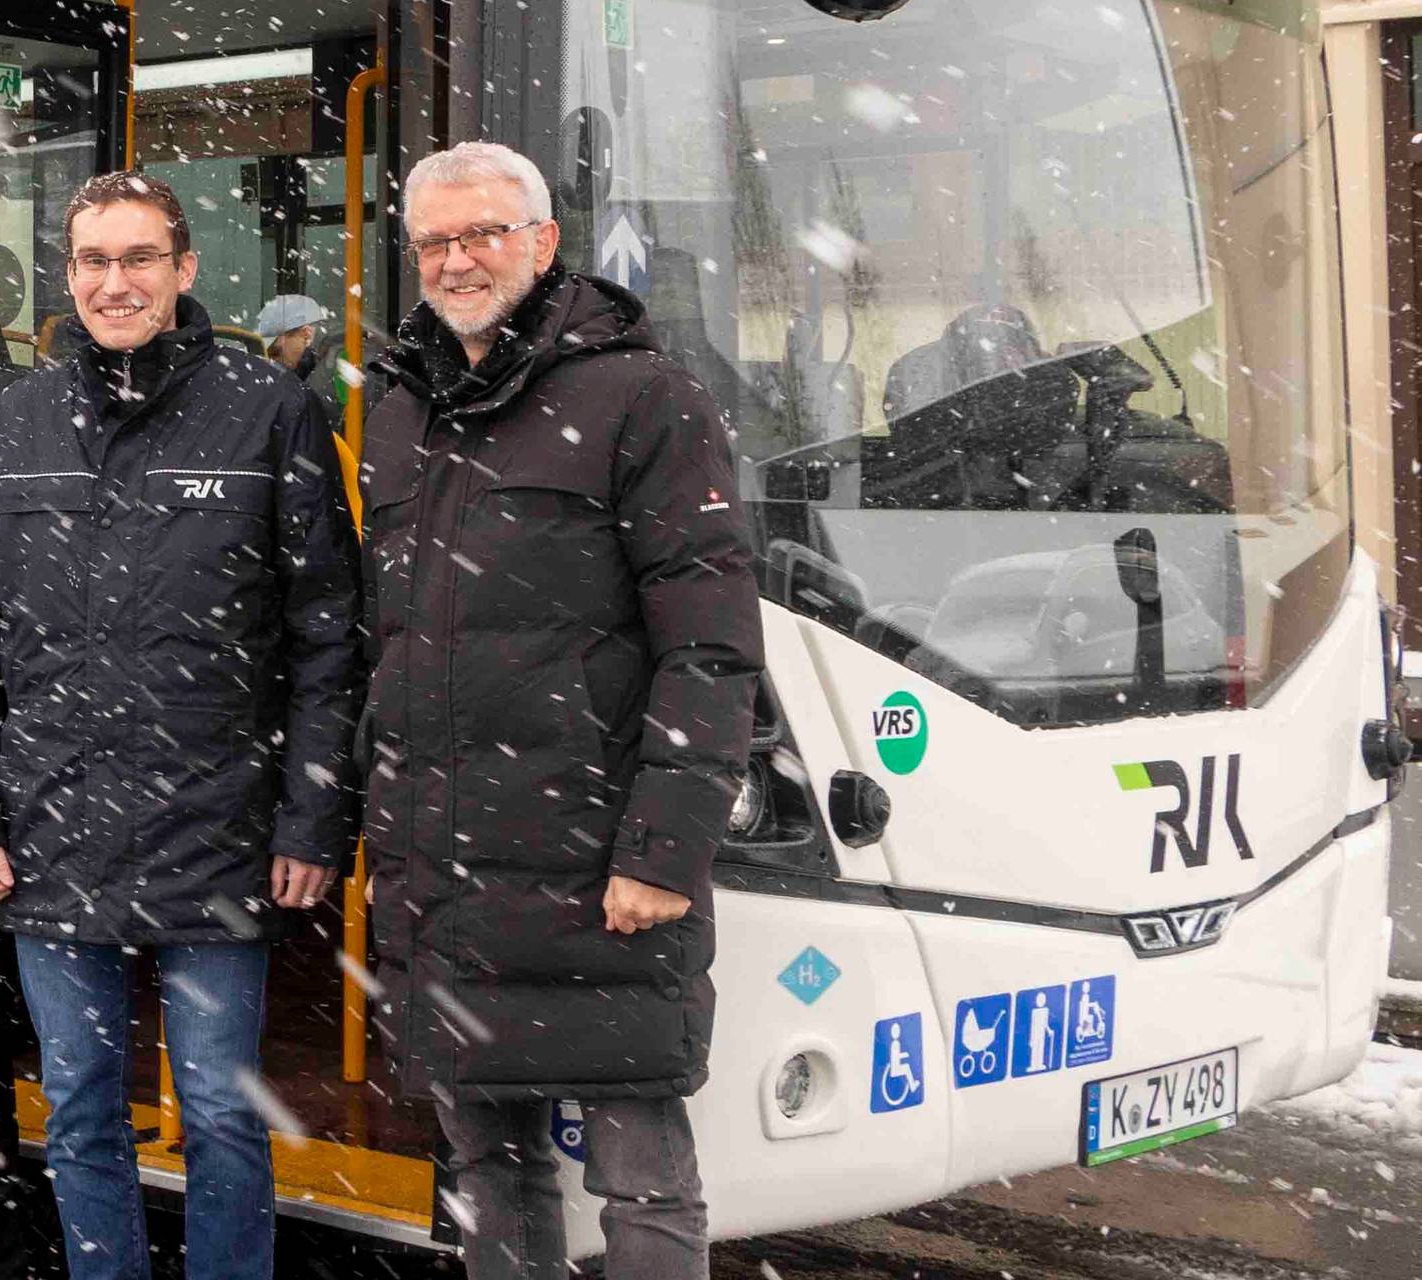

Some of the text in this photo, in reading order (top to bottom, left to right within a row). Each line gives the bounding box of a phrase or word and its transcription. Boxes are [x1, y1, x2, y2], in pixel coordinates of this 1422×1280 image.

[872, 709, 914, 736] VRS
[1112, 753, 1255, 874] RVK
[1112, 1060, 1225, 1138] K ZY 498
